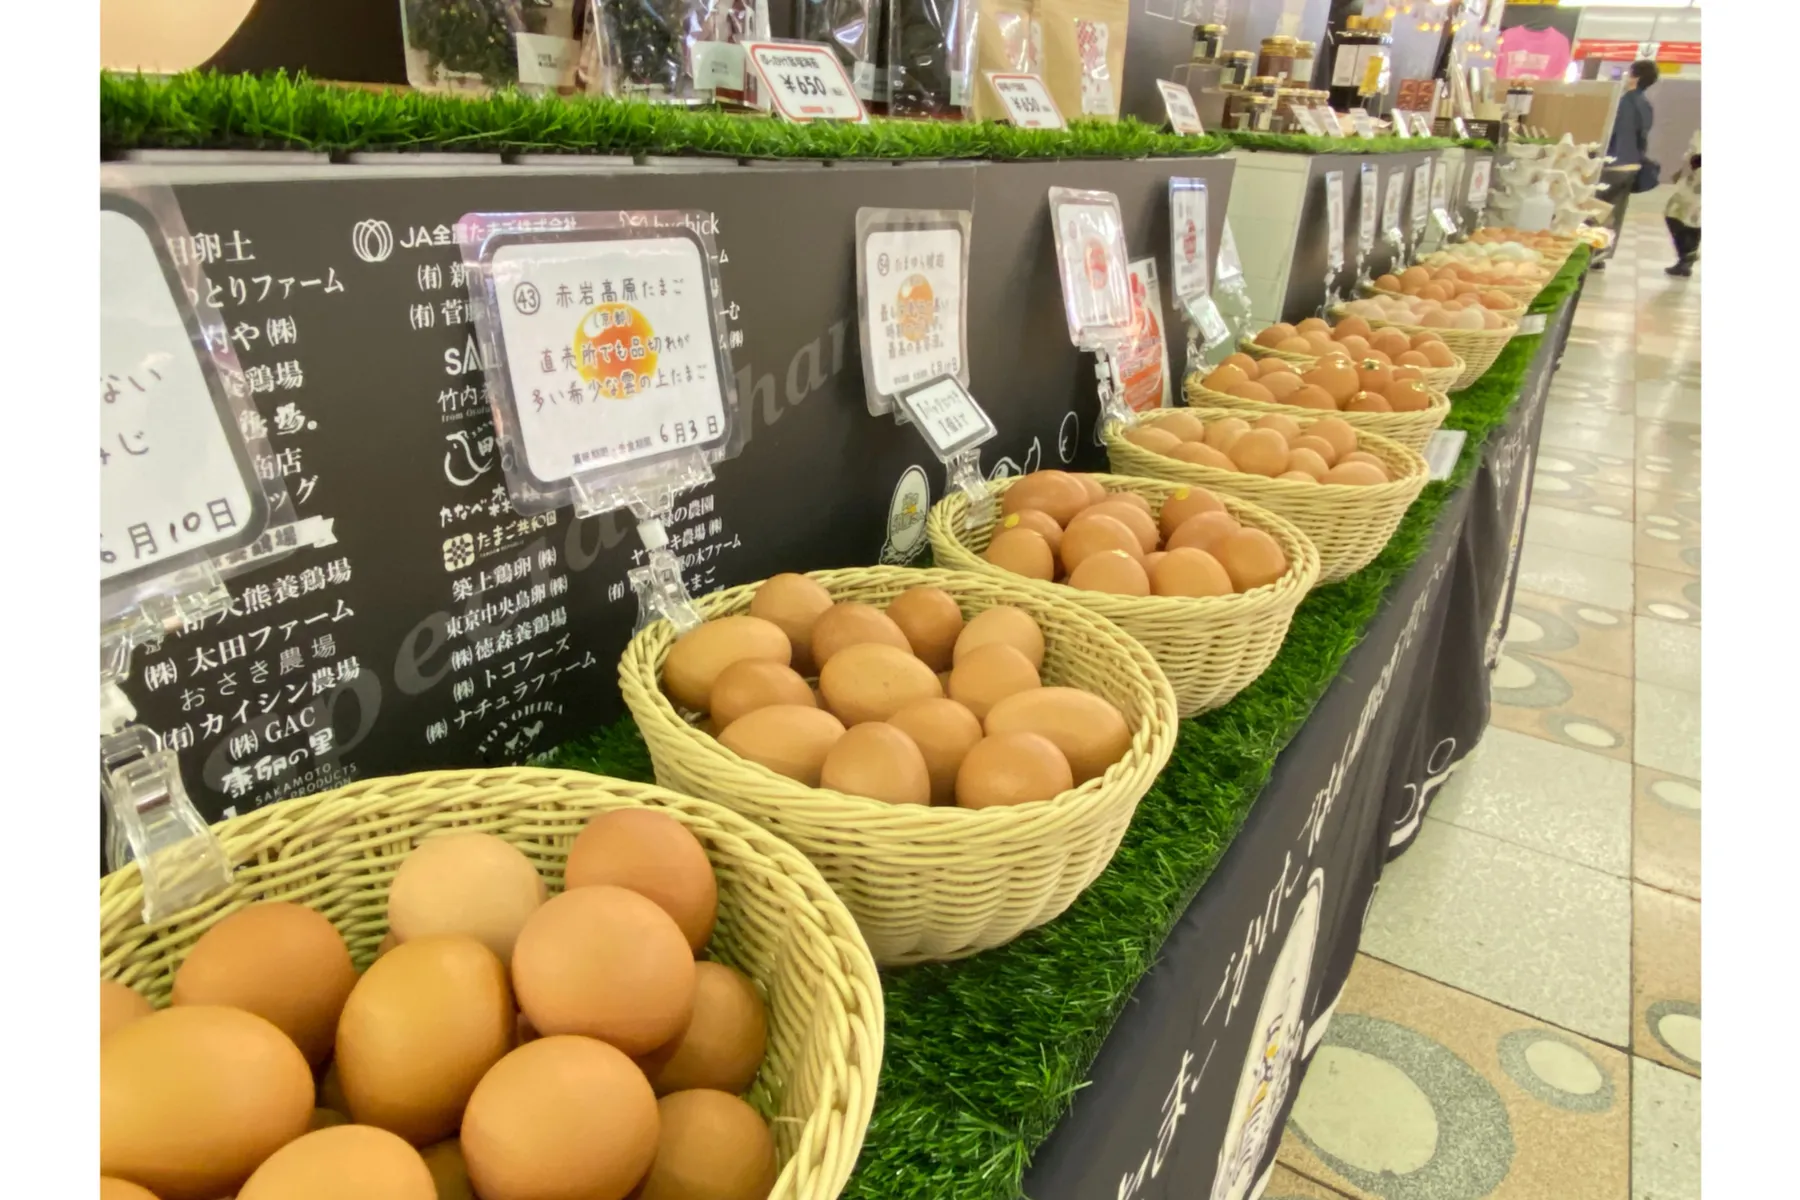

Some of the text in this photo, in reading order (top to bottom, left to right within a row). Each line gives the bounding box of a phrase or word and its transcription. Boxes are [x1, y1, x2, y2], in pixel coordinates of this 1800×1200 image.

[779, 73, 827, 96] ¥650
[515, 284, 540, 313] 43
[556, 277, 685, 308] 赤岩高原たまご
[540, 333, 691, 374] 直売所でも品切れが
[659, 415, 719, 444] 6月3日
[187, 598, 355, 677] 太田ファーム
[485, 632, 571, 689] トコフーズ
[199, 655, 360, 740] カイシン農場
[454, 651, 597, 730] ナチュラファーム
[264, 706, 317, 744] GAC
[255, 762, 333, 806] SAKAMOTO
